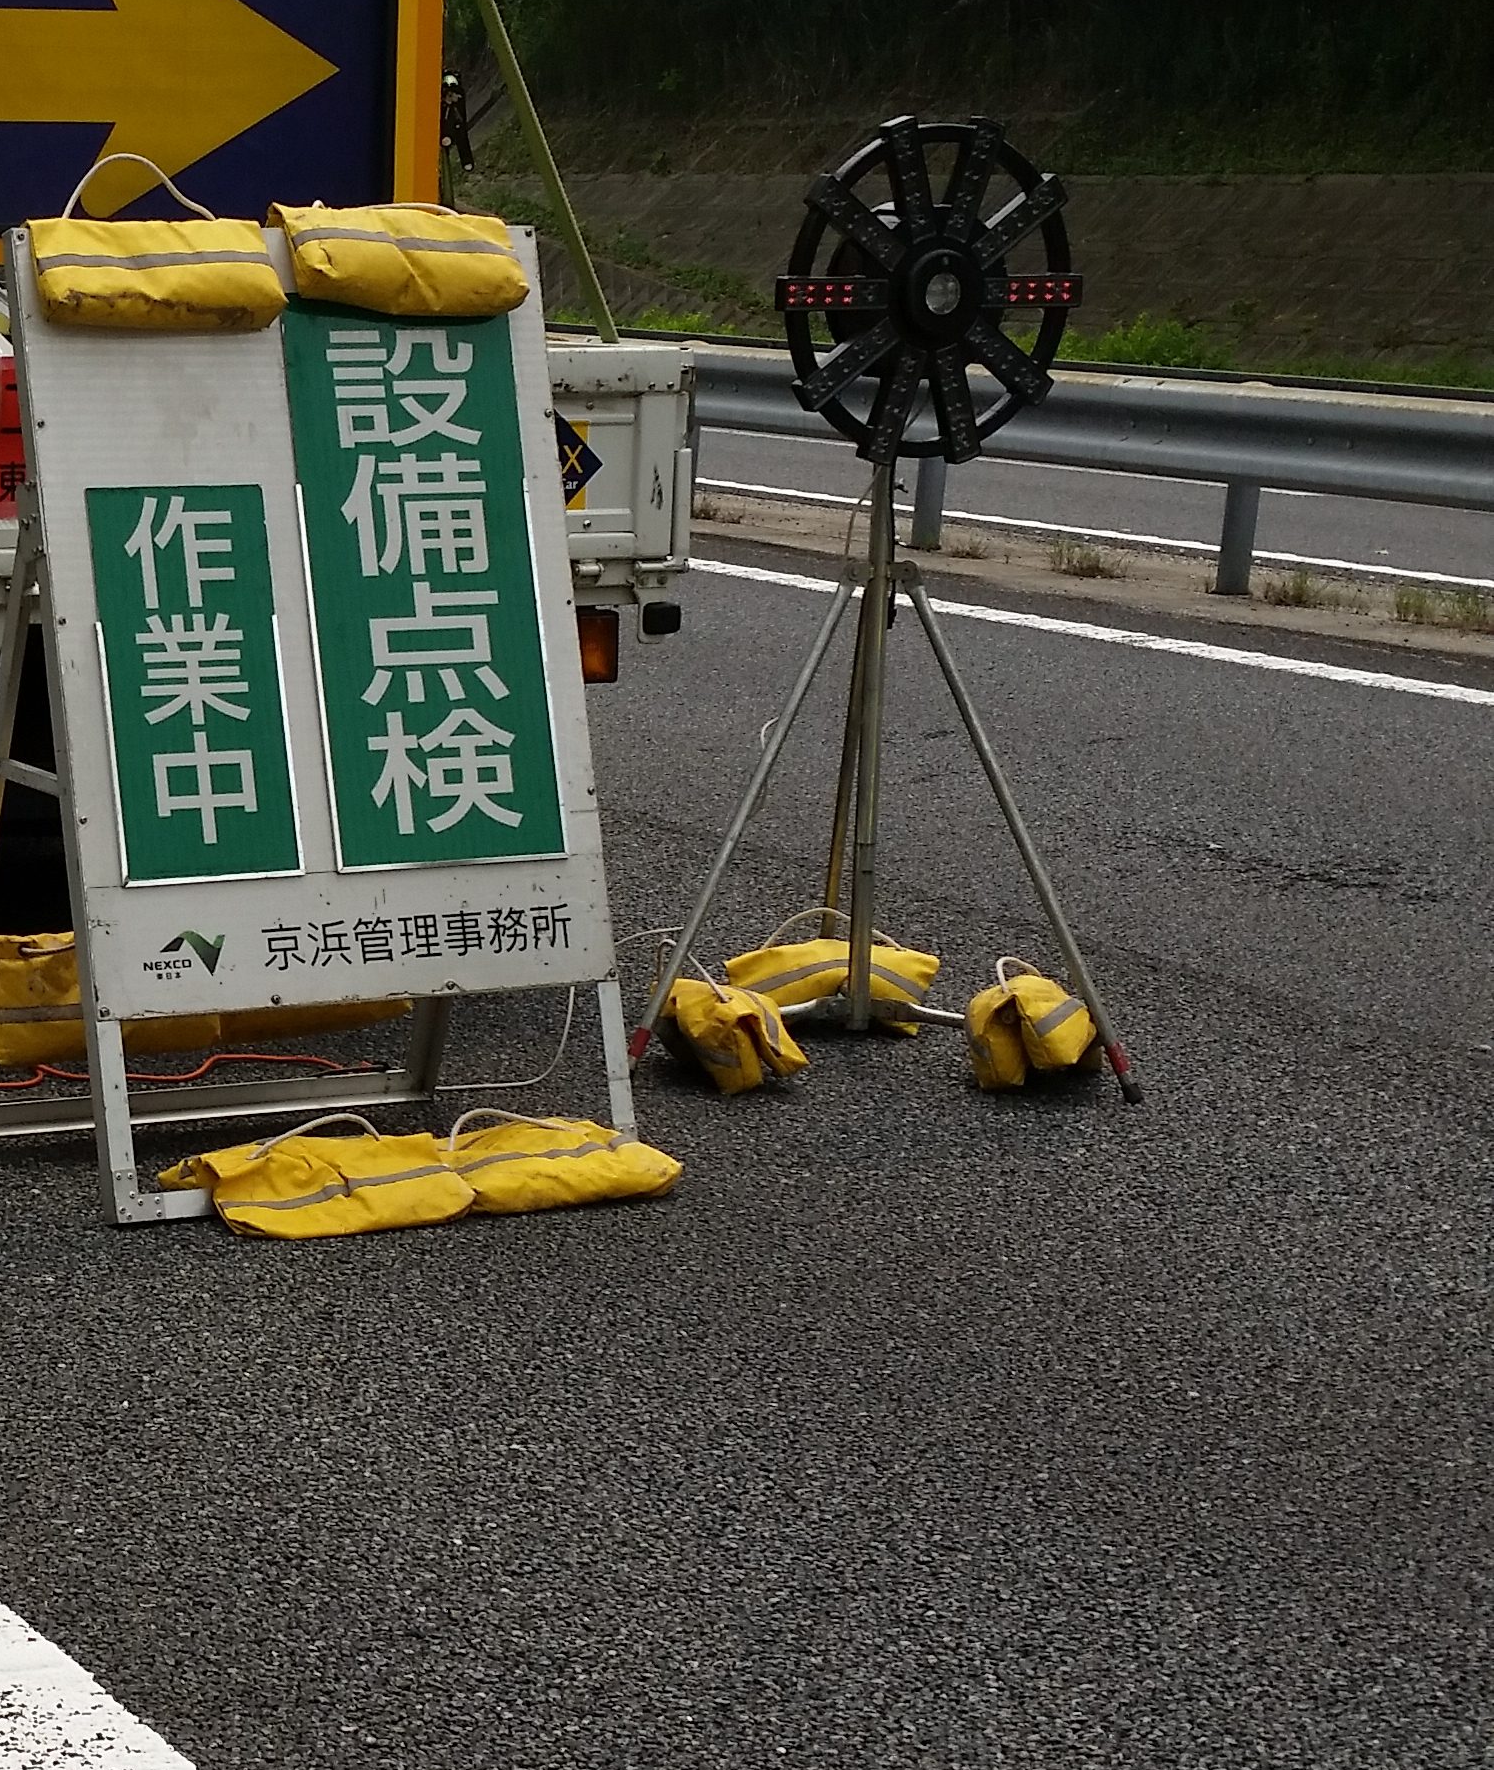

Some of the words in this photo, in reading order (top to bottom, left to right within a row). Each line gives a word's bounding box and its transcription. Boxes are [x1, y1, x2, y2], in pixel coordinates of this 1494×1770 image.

[124, 496, 258, 845] 作業中
[326, 330, 523, 836] 設備点検
[143, 959, 192, 971] NEXCO
[261, 903, 572, 971] 京浜管理事務所
